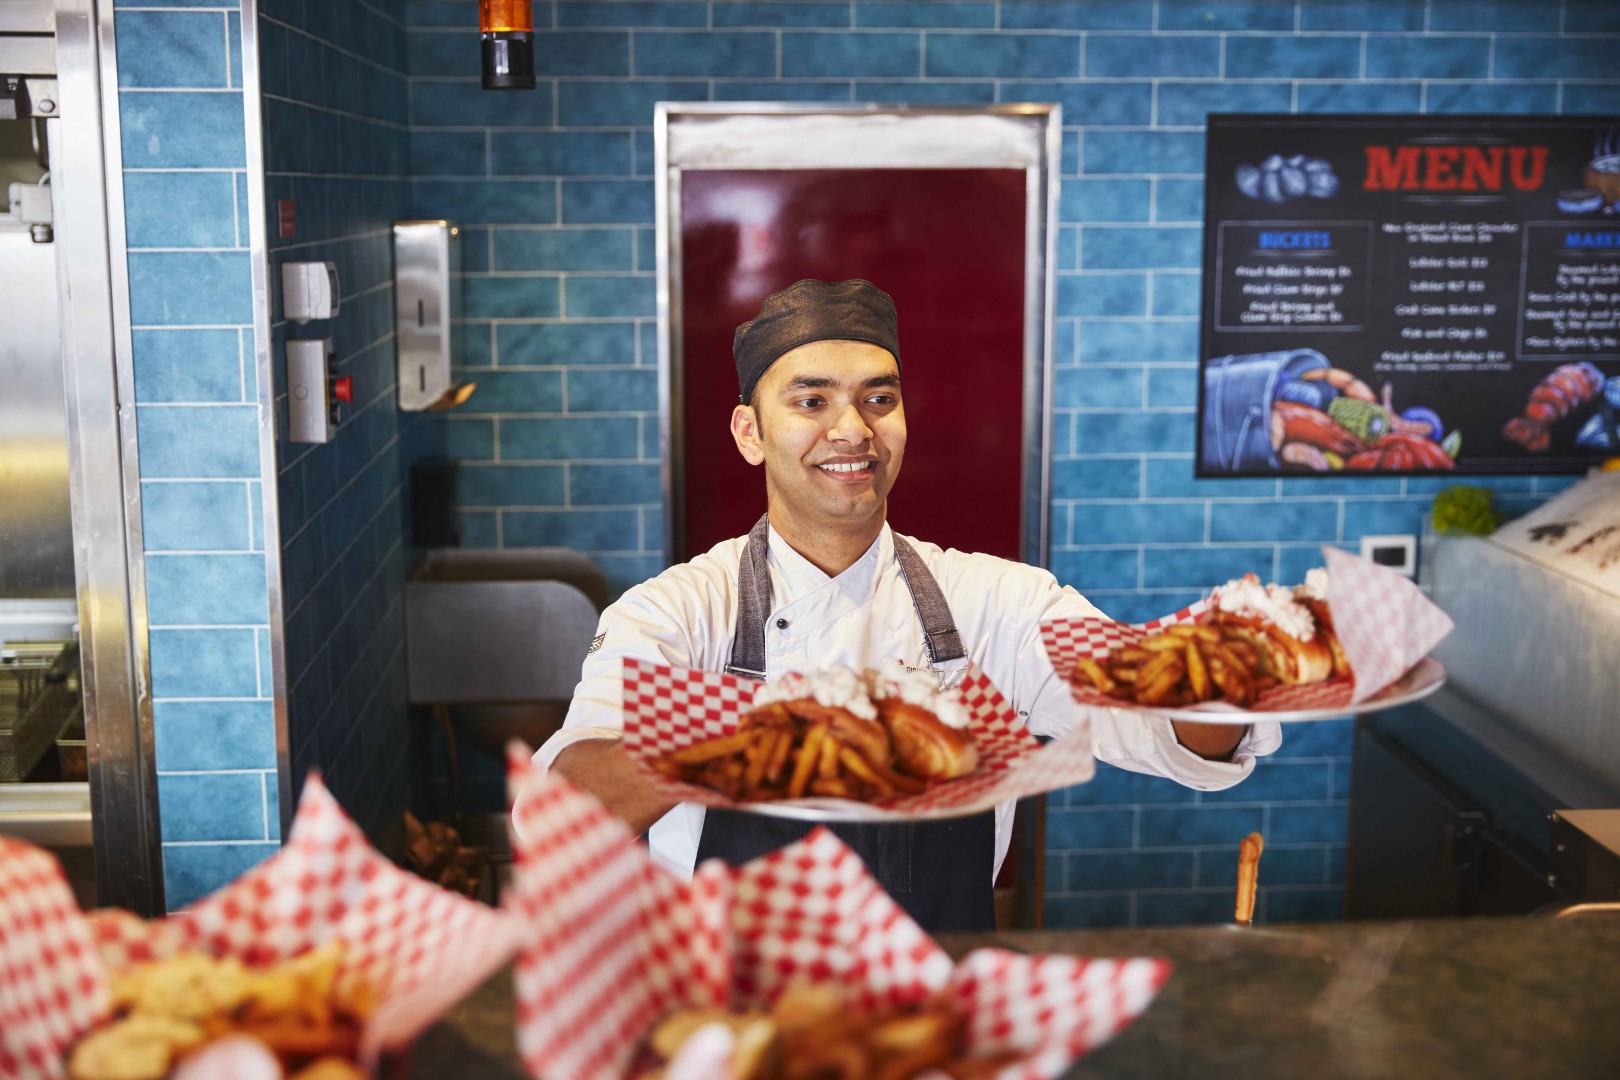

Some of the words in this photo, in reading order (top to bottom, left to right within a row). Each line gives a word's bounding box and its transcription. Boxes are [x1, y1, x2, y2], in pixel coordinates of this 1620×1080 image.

[1363, 145, 1549, 192] MENU
[1259, 231, 1332, 249] BUCKETS
[1235, 264, 1265, 278] Fried
[1242, 283, 1272, 296] Fried
